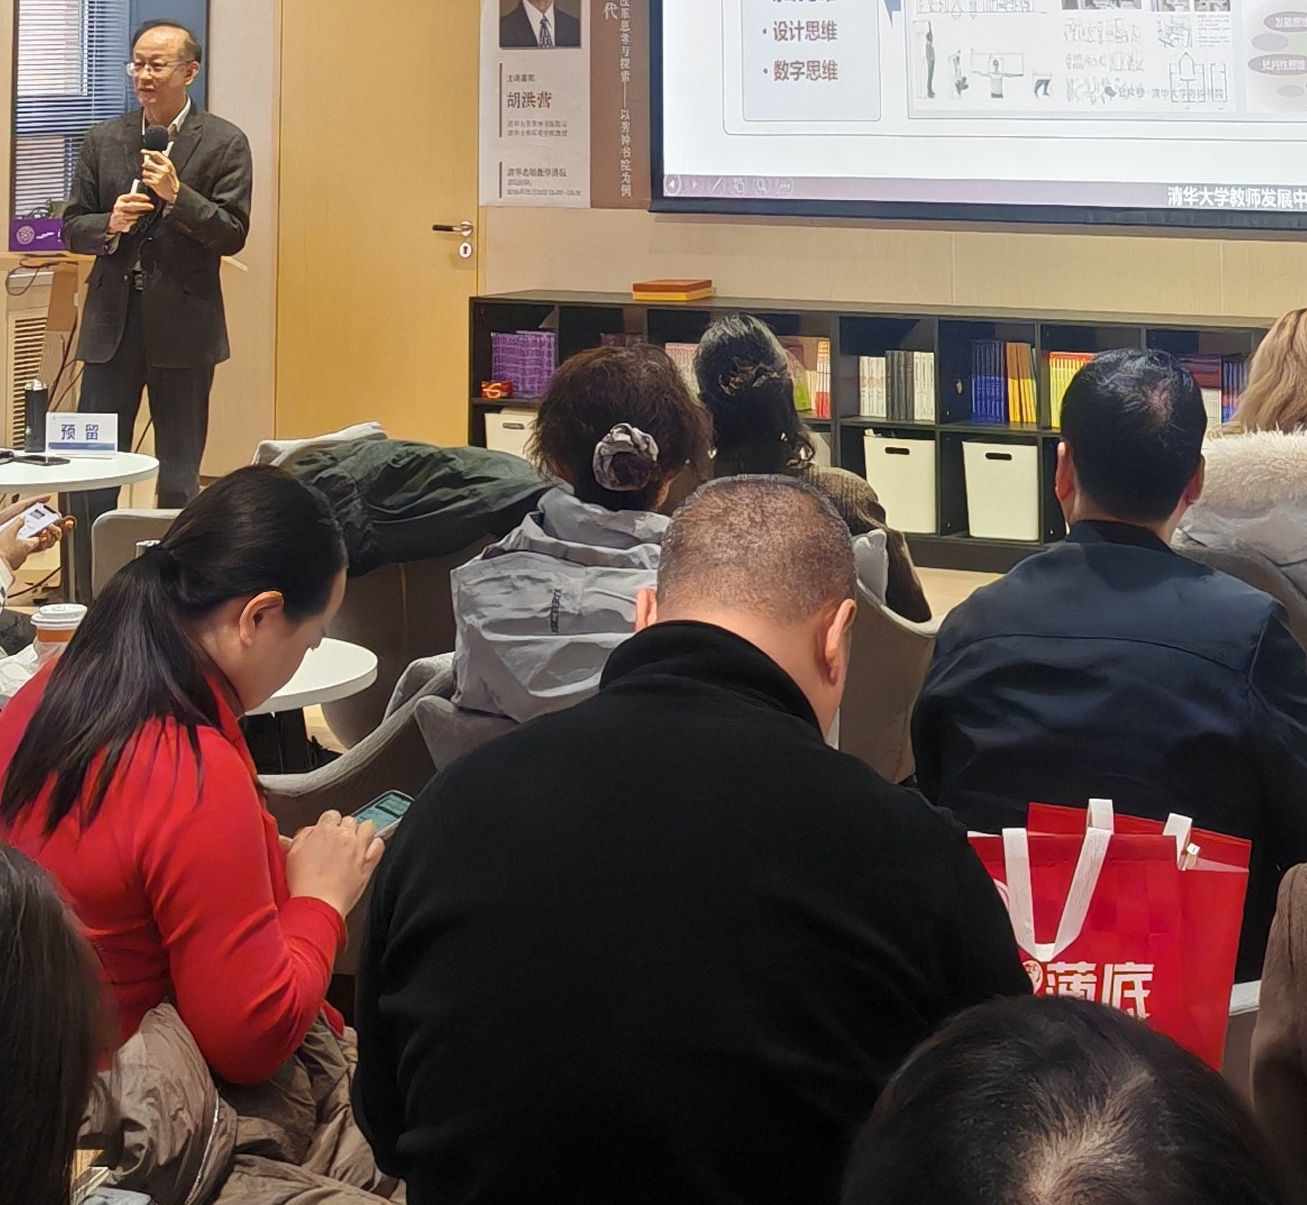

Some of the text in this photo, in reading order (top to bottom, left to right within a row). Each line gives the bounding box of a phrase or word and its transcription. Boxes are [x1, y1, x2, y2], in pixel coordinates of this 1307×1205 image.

[773, 20, 838, 42] 设计思维
[773, 59, 839, 82] 数字思维
[507, 91, 553, 109] 胡洪营
[61, 424, 99, 441] 预留
